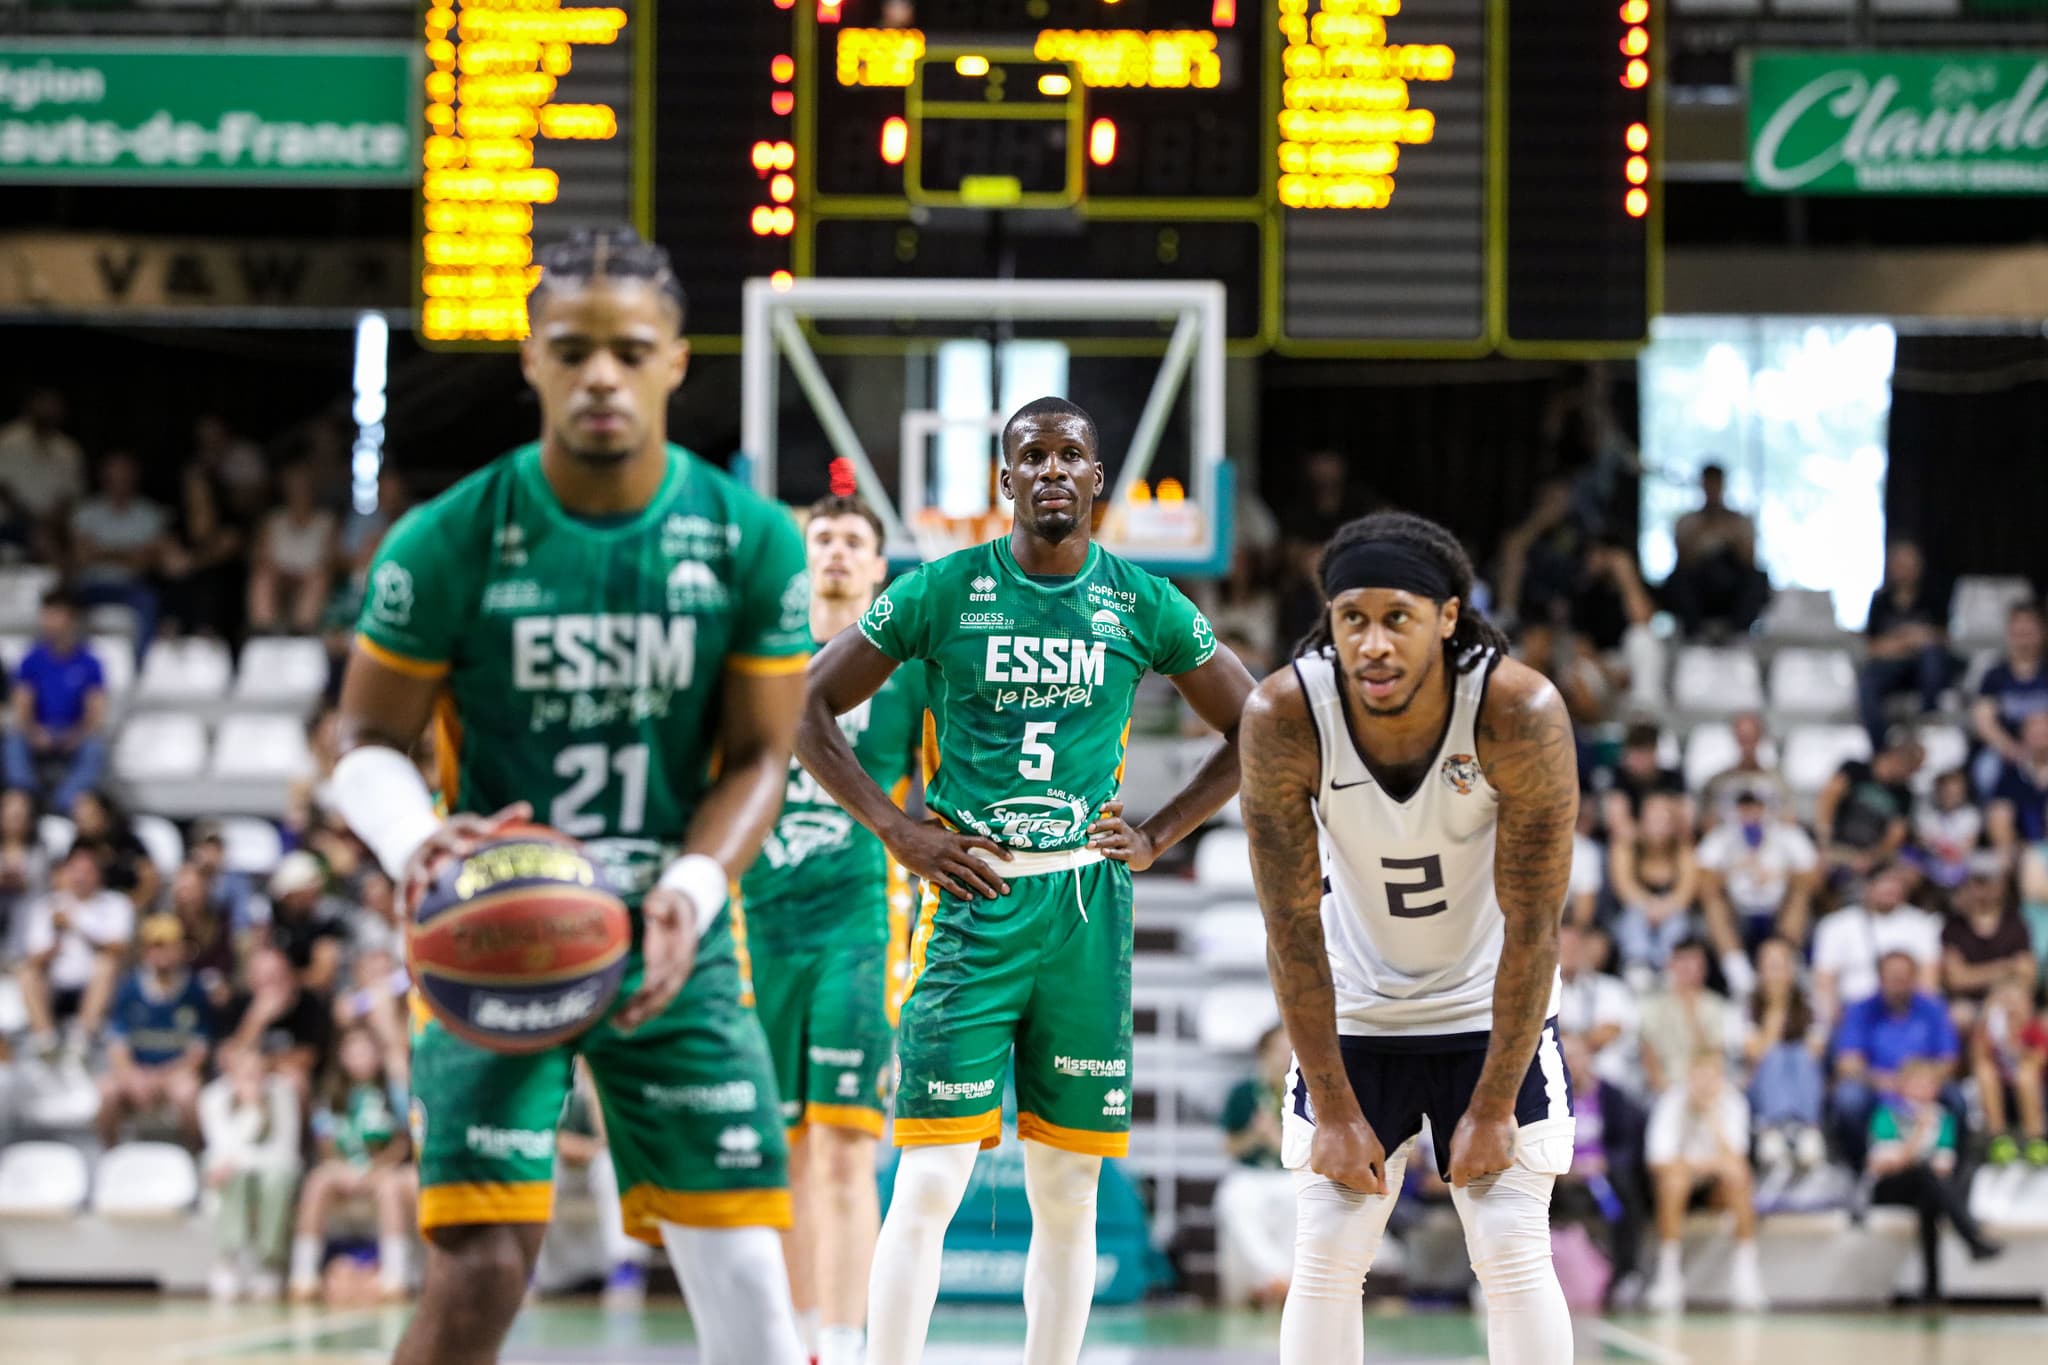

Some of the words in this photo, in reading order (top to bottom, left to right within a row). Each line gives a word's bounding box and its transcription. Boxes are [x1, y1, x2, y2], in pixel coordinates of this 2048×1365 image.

[960, 612, 1004, 622] CODESS
[1091, 622, 1127, 638] CODESS
[1102, 598, 1135, 614] BOECK
[512, 612, 697, 693] ESSM
[985, 635, 1107, 686] ESSM
[1018, 721, 1057, 782] 5
[550, 741, 652, 838] 21
[1380, 854, 1448, 919] 2
